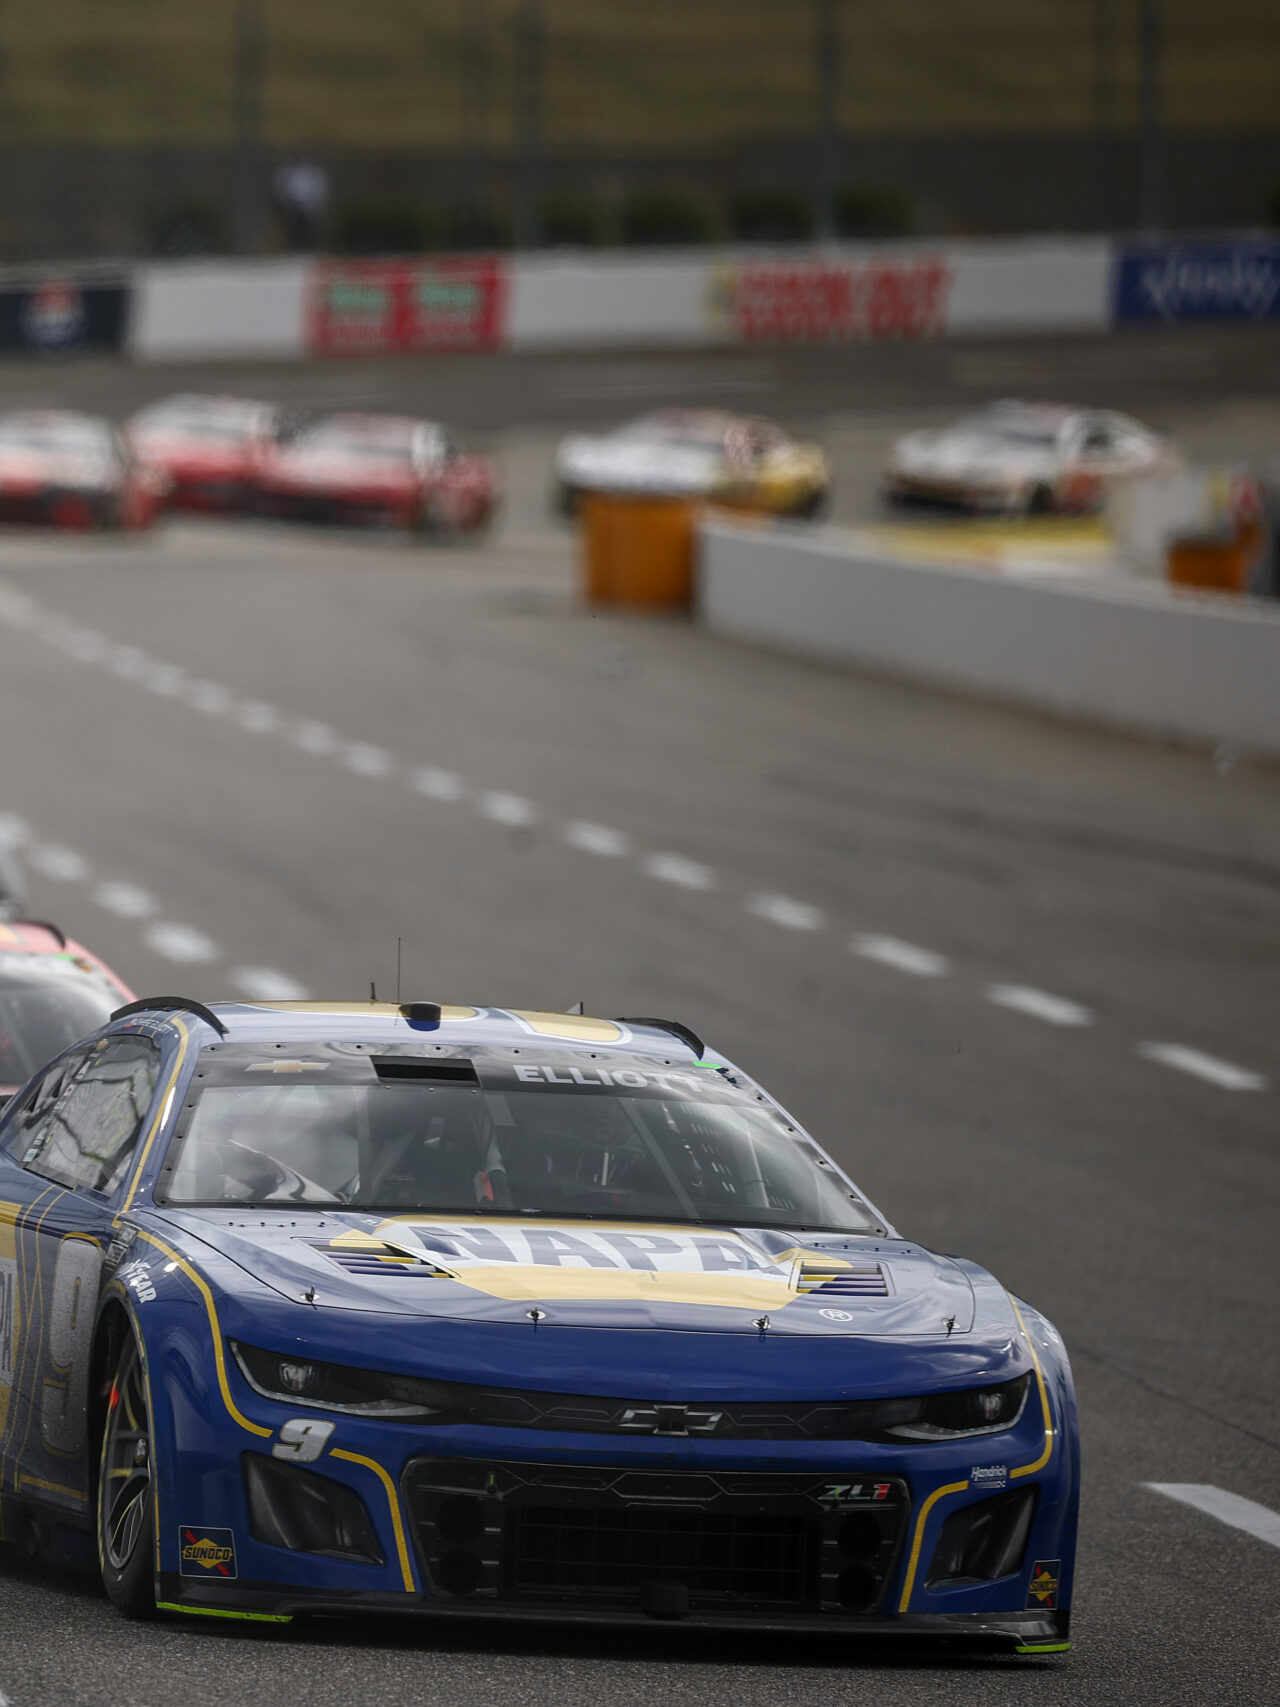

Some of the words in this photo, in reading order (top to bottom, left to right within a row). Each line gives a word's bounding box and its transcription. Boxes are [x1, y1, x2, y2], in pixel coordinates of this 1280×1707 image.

[513, 1064, 703, 1093] ELLIOTT
[408, 1225, 783, 1276] NAPA
[272, 1418, 336, 1463] 9
[817, 1483, 891, 1500] ZL1
[184, 1547, 231, 1561] SUNOCO
